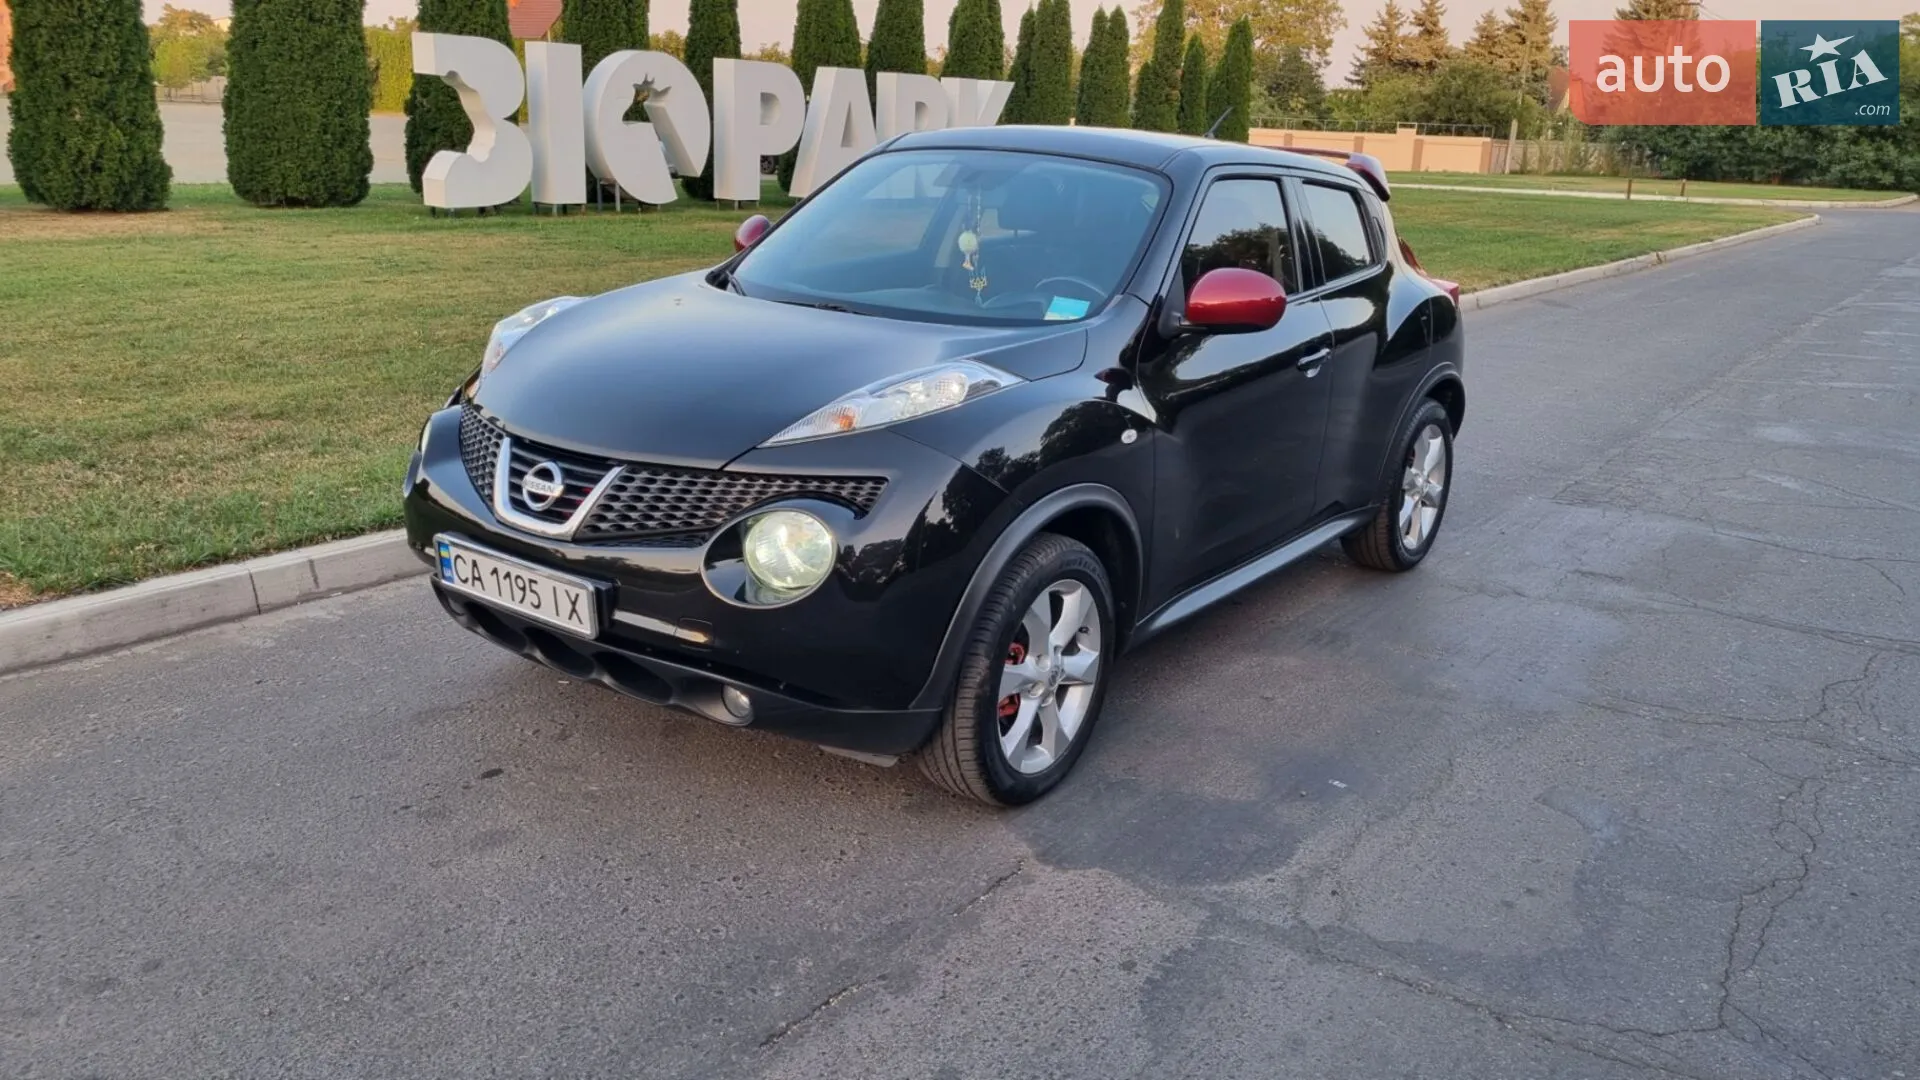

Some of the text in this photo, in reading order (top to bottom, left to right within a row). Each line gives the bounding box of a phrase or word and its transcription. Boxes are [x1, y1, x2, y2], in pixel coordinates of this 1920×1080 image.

[453, 554, 584, 625] CA 1195 IX
